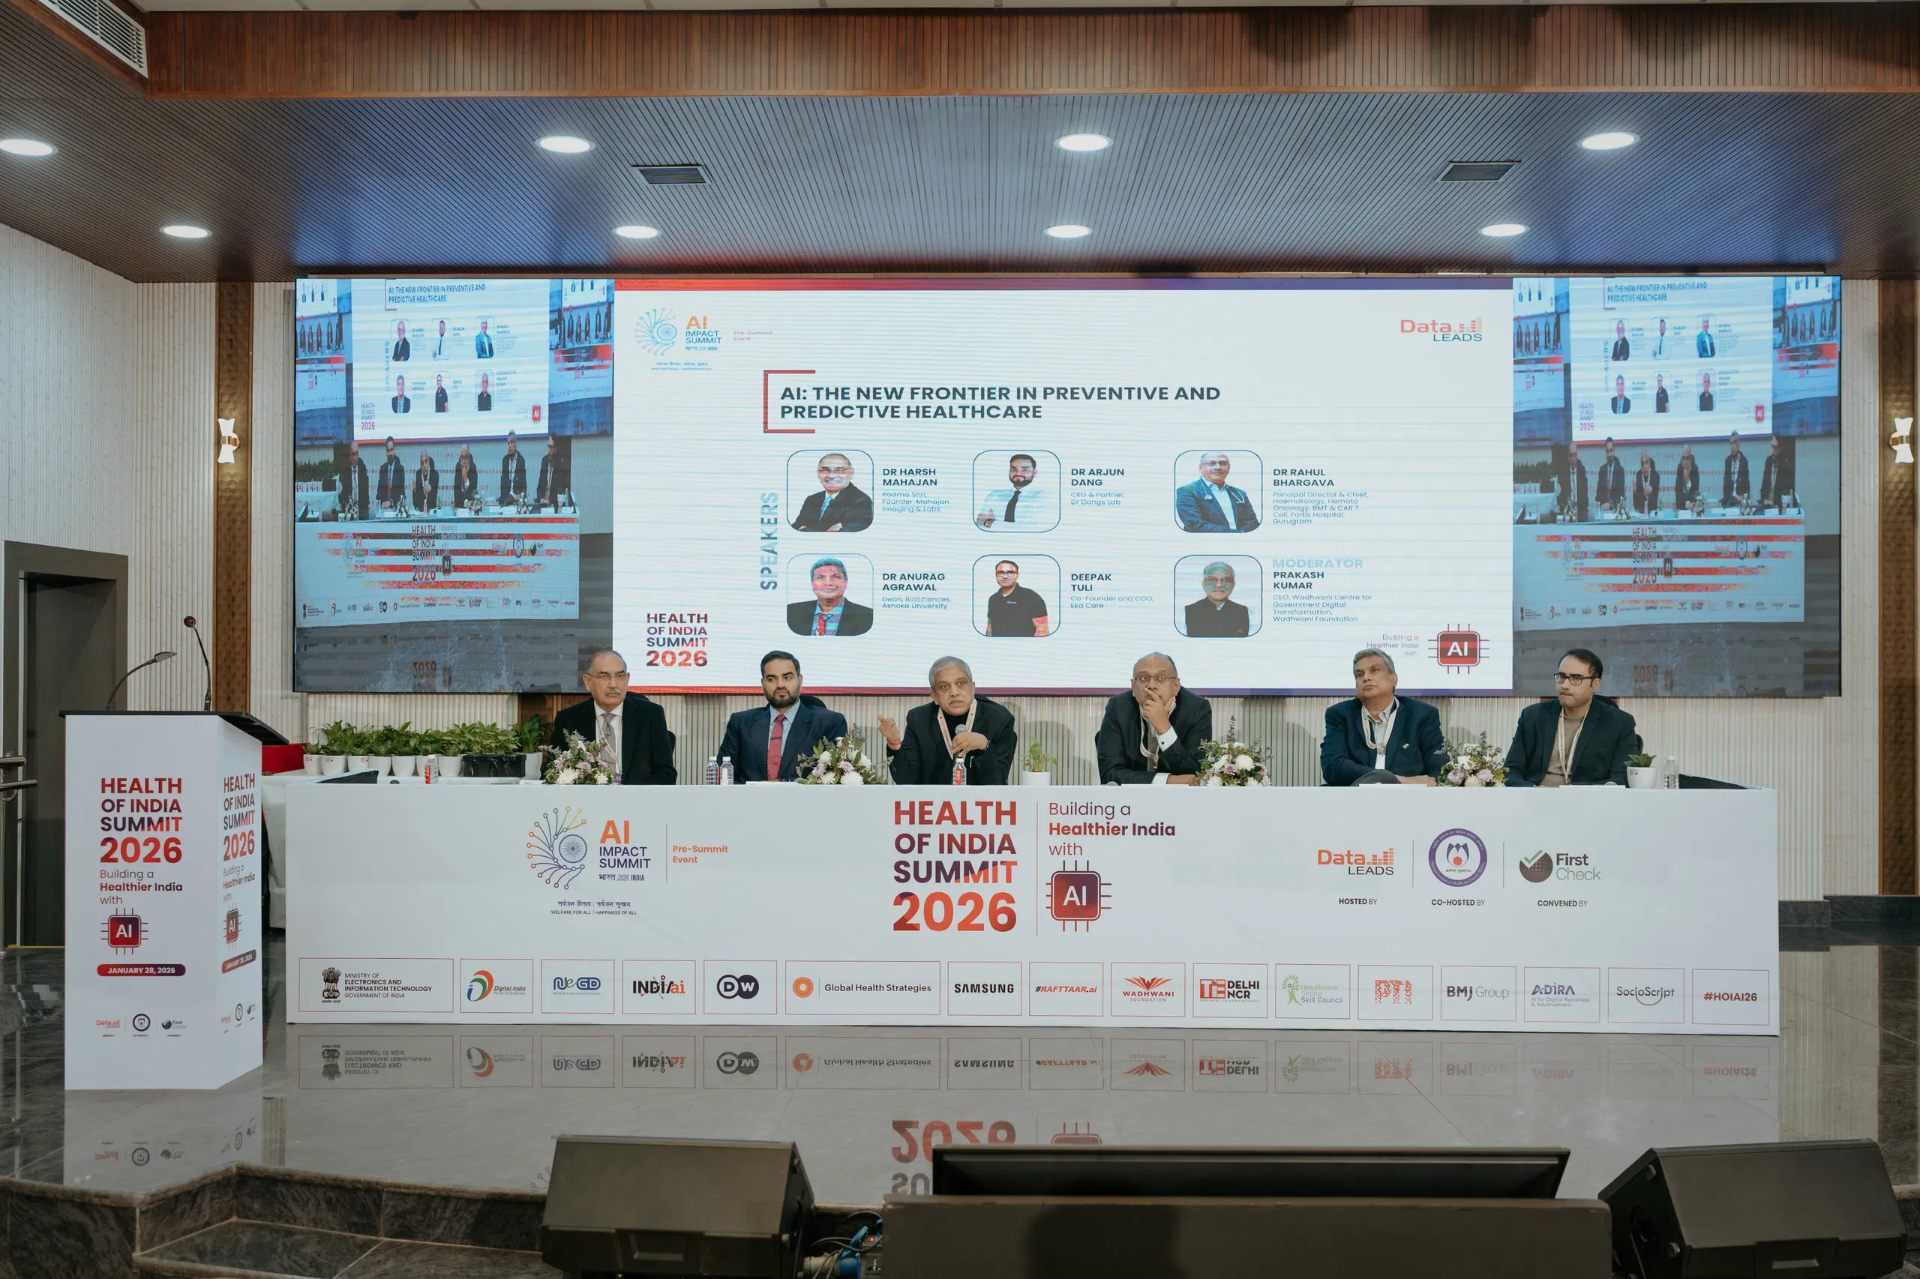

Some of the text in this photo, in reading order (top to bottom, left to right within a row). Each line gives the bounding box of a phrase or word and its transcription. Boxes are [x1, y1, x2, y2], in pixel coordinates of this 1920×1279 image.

[687, 315, 708, 330] AI
[1400, 320, 1452, 333] Data
[1433, 334, 1482, 342] LEADS
[780, 386, 1220, 400] AI: THE NEW FRONTIER IN PREVENTIVE AND
[780, 405, 1042, 419] PREDICTIVE HEALTHCARE
[760, 492, 778, 590] SPEAKERS
[1272, 559, 1364, 568] MODERATOR
[647, 613, 708, 623] HEALTH
[647, 626, 708, 635] OF INDIA
[646, 638, 708, 647] SUMMIT
[1448, 642, 1469, 656] AI
[646, 650, 708, 666] 2026
[101, 778, 182, 793] HEALTH
[224, 773, 255, 793] HEALTH
[101, 799, 182, 812] OF INDIA
[224, 794, 254, 811] OF INDIA
[894, 801, 1016, 825] HEALTH
[1049, 802, 1131, 819] Building a
[101, 817, 182, 832] SUMMIT
[224, 810, 255, 830] SUMMIT
[600, 820, 630, 844] AI
[1049, 822, 1175, 836] Healthier India
[100, 837, 182, 863] 2026
[224, 830, 254, 862] 2026
[895, 833, 1016, 854] OF INDIA
[1049, 842, 1083, 856] with
[600, 847, 647, 856] IMPACT
[1317, 849, 1366, 865] Data
[599, 858, 651, 868] SUMMIT
[1556, 853, 1589, 866] First
[100, 870, 144, 881] Building
[894, 861, 1017, 884] SUMMIT
[1348, 866, 1394, 875] LEADS
[1556, 868, 1601, 881] Check
[100, 882, 182, 892] Healthier India
[100, 895, 123, 904] with
[1062, 886, 1086, 906] AI
[893, 892, 1017, 932] 2026
[116, 924, 132, 938] AI
[229, 918, 236, 934] AI
[145, 967, 156, 975] 28,
[554, 977, 601, 990] NeGD
[824, 984, 931, 993] Global Health Strategies
[954, 983, 1014, 994] SAMSUNG
[1228, 980, 1260, 989] DELHI
[1228, 990, 1250, 999] NCR
[1447, 985, 1509, 1001] BMJ Group
[1617, 986, 1675, 999] SocioScript
[1704, 992, 1758, 1002] #HOIAI26
